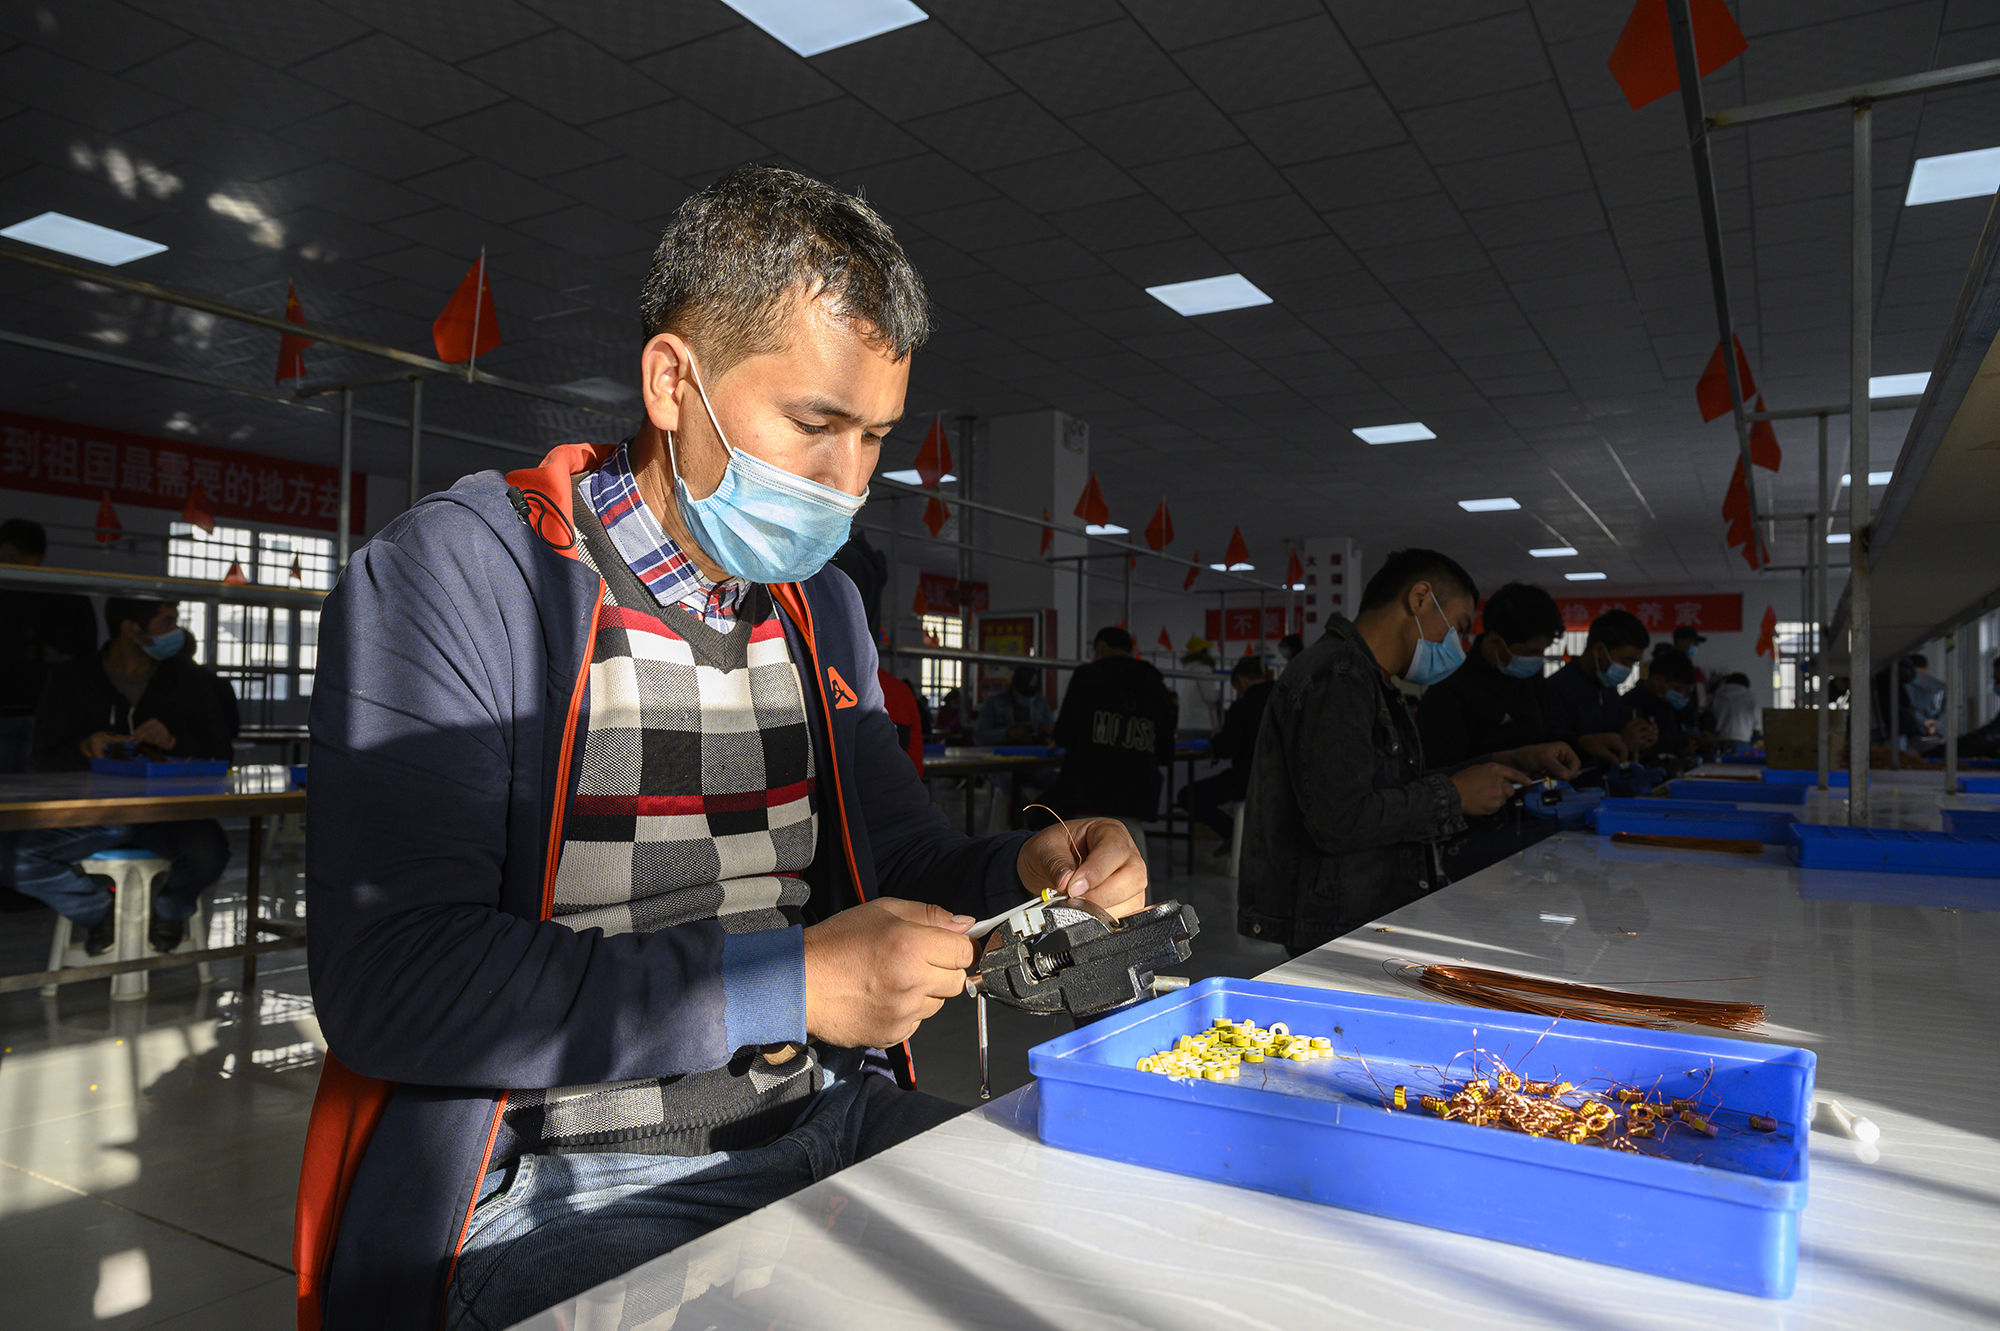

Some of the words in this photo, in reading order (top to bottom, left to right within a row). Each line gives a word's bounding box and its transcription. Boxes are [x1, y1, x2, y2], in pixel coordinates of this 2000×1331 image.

[3, 425, 341, 519] 到祖国最需要的地方去
